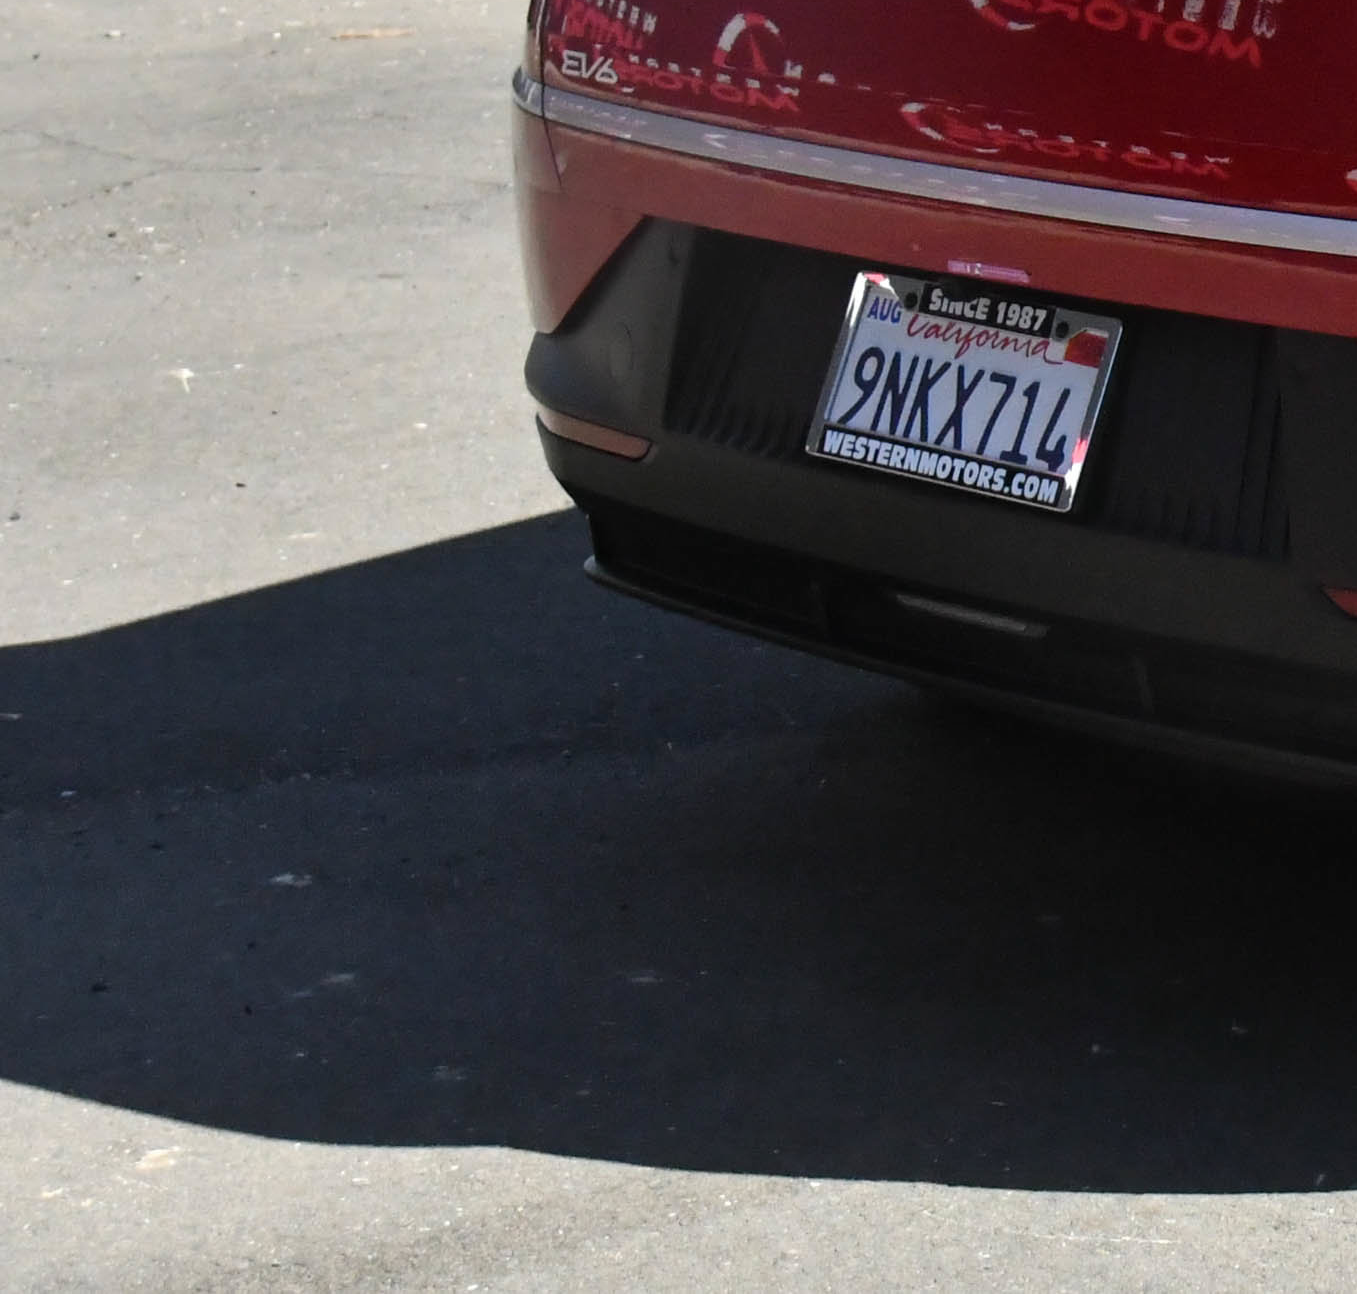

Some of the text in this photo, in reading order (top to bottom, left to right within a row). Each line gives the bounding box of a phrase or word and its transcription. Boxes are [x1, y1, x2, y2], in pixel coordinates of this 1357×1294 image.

[562, 50, 618, 84] EV6
[867, 296, 901, 324] AUG
[996, 300, 1048, 333] 1987
[906, 312, 1064, 365] California
[836, 346, 1072, 472] 9NKX714
[823, 428, 1060, 505] WESTERNMOTORS.COM
